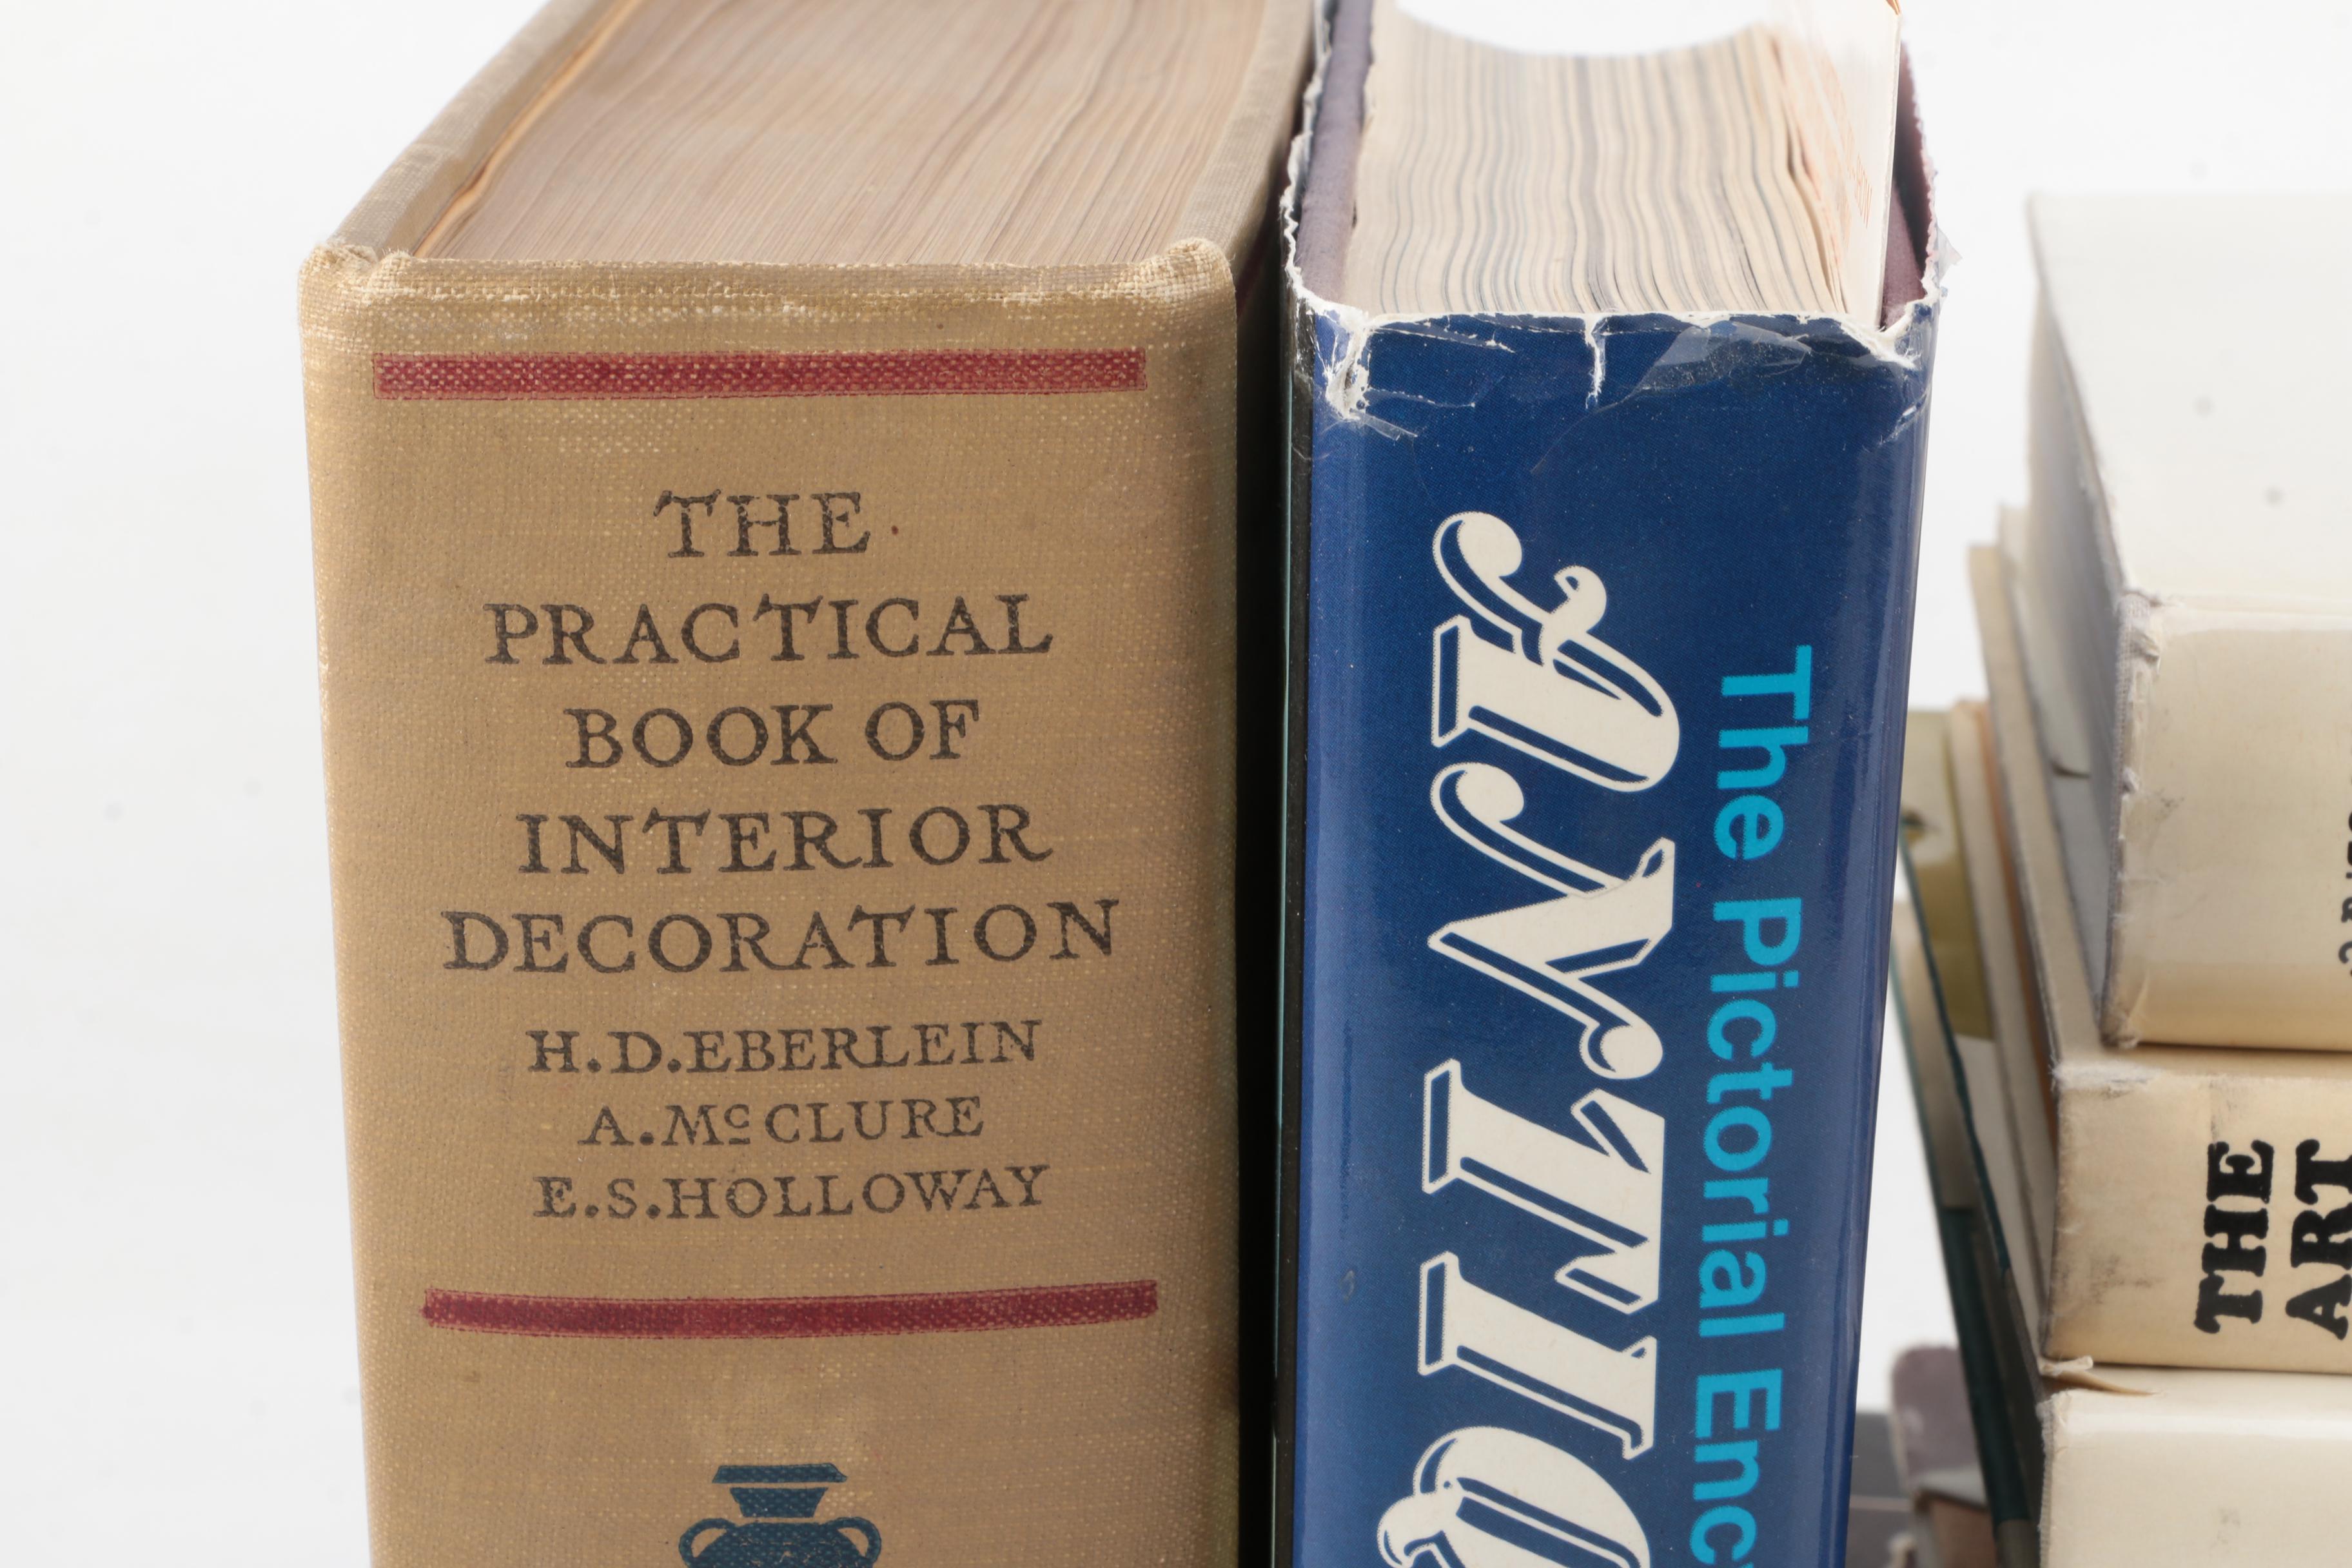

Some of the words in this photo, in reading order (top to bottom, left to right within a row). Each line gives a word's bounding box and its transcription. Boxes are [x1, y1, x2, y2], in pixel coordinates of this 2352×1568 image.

[653, 489, 870, 558] THE
[484, 594, 1054, 665] PRACTICAL
[564, 703, 838, 769] BOOK
[865, 699, 979, 761] OF
[1714, 645, 1812, 861] The
[516, 803, 1053, 875] INTERIOR
[441, 899, 1119, 974] DECORATION
[527, 1020, 1041, 1074] H.D.EBERLEIN
[1698, 897, 1803, 1337] Pictorial
[534, 1165, 1050, 1220] E.S.HOLLOWAY
[2193, 1139, 2275, 1334] THE
[2285, 1139, 2352, 1340] ART
[1689, 1368, 1783, 1568] Enc
